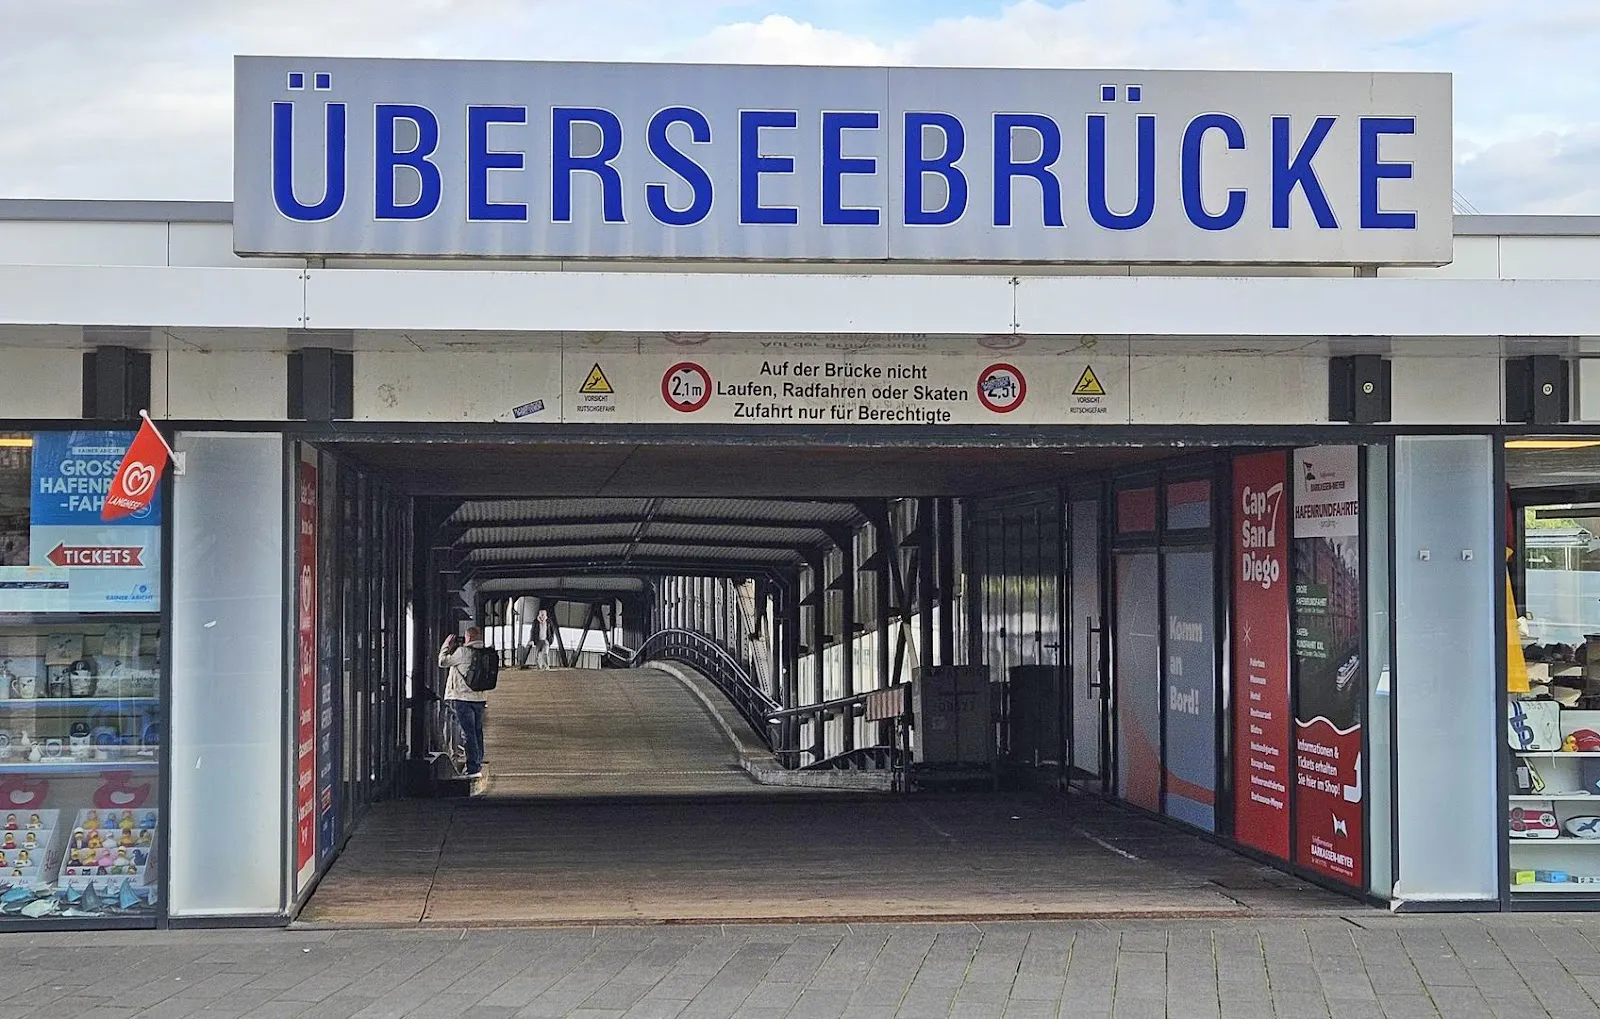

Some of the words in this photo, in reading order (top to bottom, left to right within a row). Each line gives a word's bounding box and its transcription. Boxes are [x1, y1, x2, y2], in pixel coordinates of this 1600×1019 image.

[272, 72, 1418, 232] ÜBERSEEBRÜCKE
[760, 361, 789, 376] Auf
[793, 362, 819, 377] der
[825, 362, 882, 378] Brücke
[887, 364, 927, 379] nicht
[717, 381, 777, 399] Laufen,
[783, 382, 866, 399] Radfahren
[872, 385, 908, 400] oder
[913, 385, 968, 401] Skaten
[734, 402, 793, 418] Zufahrt
[798, 407, 825, 419] nur
[830, 405, 853, 420] für
[858, 405, 951, 425] Berechtigte
[1242, 519, 1266, 548] San
[64, 549, 131, 564] TICKETS
[1242, 551, 1280, 590] Diego
[1169, 615, 1203, 643] Komm
[1169, 655, 1183, 677] an
[1169, 685, 1199, 715] Bord!
[1297, 739, 1333, 758] Informationen
[1333, 746, 1340, 759] &
[1297, 755, 1315, 772] Tickets
[1315, 760, 1337, 777] erhalten
[1297, 773, 1306, 786] Sie
[1306, 774, 1317, 789] hier
[1317, 777, 1324, 791] im
[1324, 780, 1341, 798] Shop!
[1310, 844, 1354, 869] BARKASSEN-MEYER
